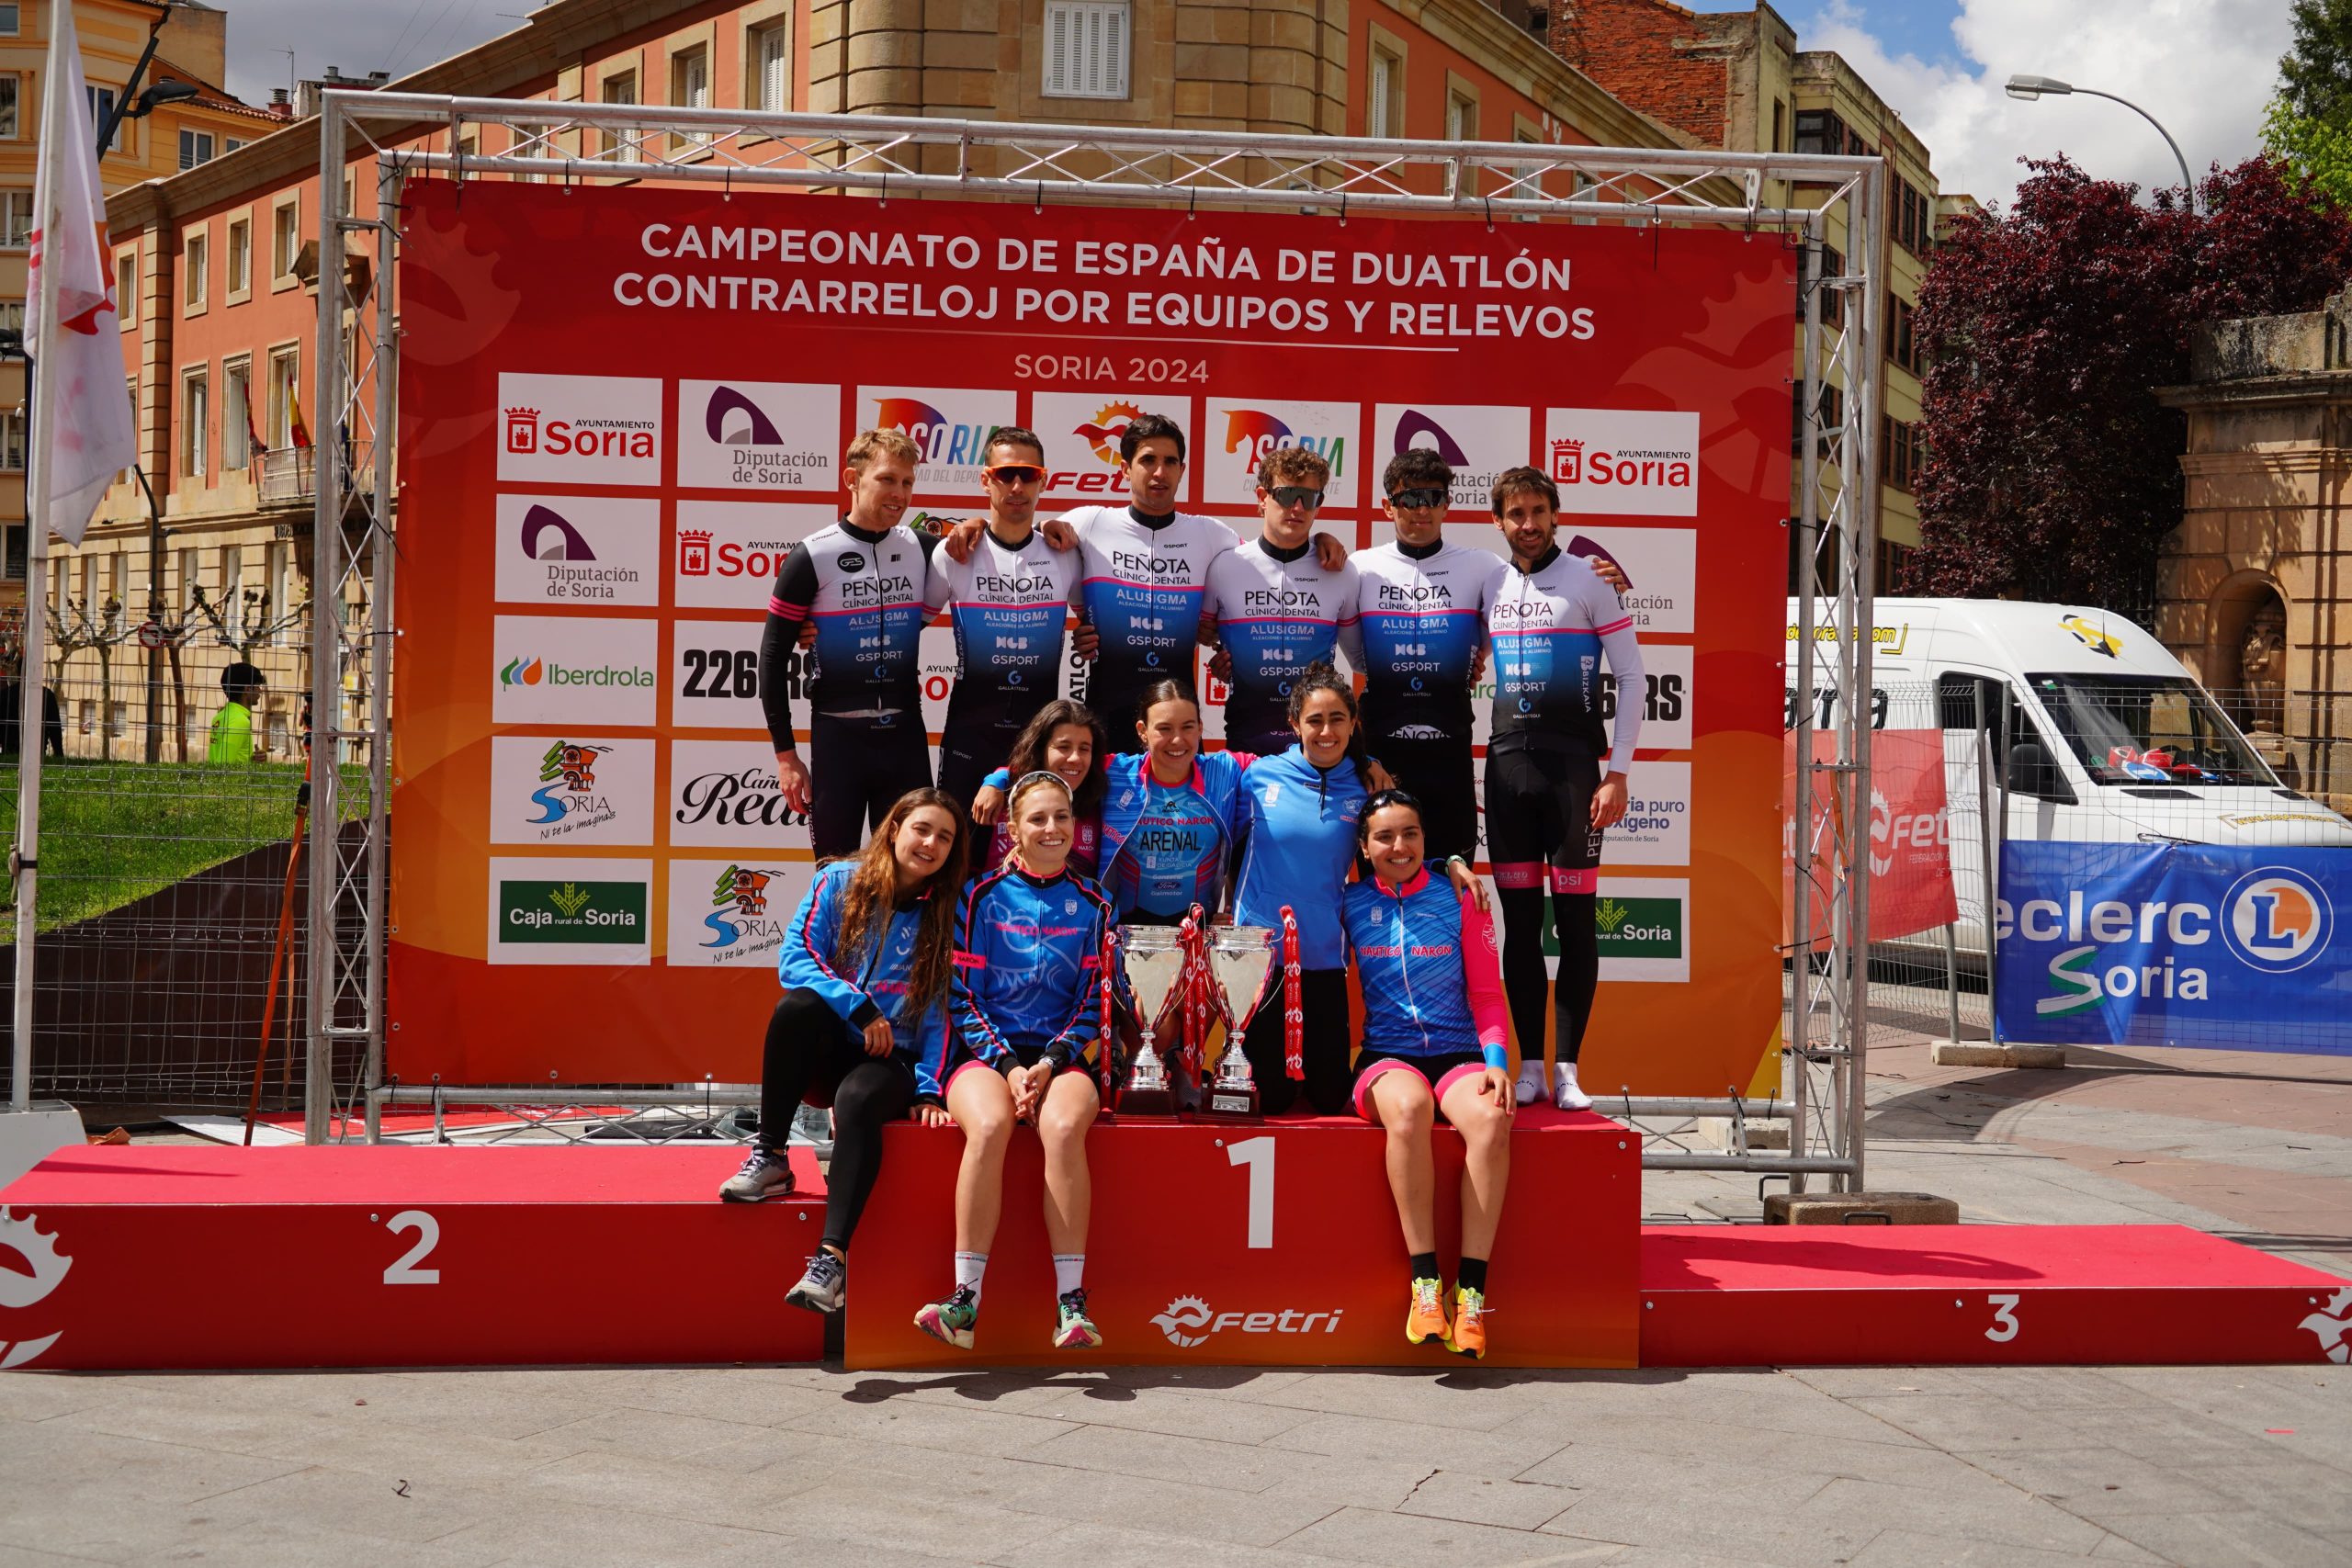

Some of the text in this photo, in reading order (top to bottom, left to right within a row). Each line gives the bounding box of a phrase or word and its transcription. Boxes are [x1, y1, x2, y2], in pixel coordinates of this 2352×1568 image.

[640, 223, 1572, 291] CAMPEONATO DE ESPAÑA DE DUATLÓN
[613, 272, 1596, 340] CONTRARRELOJ POR EQUIPOS Y RELEVOS
[1013, 354, 1209, 384] SORIA 2024
[574, 419, 655, 430] AYUNTAMIENTO
[543, 421, 654, 458] Soria
[732, 449, 829, 469] Diputación
[1616, 449, 1691, 459] AYUNTAMIENTO
[732, 468, 803, 485] de Soria
[1587, 451, 1690, 487] Soria
[1113, 550, 1191, 574] PEÑOTA
[547, 565, 639, 583] Diputación
[977, 573, 1054, 593] PEÑOTA
[1113, 568, 1192, 586] CLÍNICA DENTAL
[547, 582, 615, 598] de Soria
[842, 576, 912, 597] PEÑOTA
[1379, 583, 1452, 602] PEÑOTA
[842, 593, 914, 609] CLÍNICA DENTAL
[978, 592, 1054, 604] CLÍNICA DENTAL
[1116, 588, 1187, 604] ALUSIGMA
[1244, 586, 1320, 607] PEÑOTA
[1245, 607, 1320, 618] CLÍNICA DENTAL
[1378, 600, 1453, 612] CLÍNICA DENTAL
[1493, 599, 1554, 619] PEÑOTA
[984, 610, 1049, 622] ALUSIGMA
[1493, 619, 1555, 630] CLÍNICA DENTAL
[1250, 625, 1315, 636] ALUSIGMA
[1126, 635, 1177, 648] GSPORT
[855, 650, 903, 662] GSPORT
[991, 655, 1040, 665] GSPORT
[548, 664, 654, 687] Iberdrola
[1260, 666, 1307, 677] GSPORT
[1391, 661, 1441, 673] GSPORT
[1505, 682, 1546, 693] GSPORT
[1581, 671, 1592, 714] BIZKAIA
[526, 782, 612, 824] SORIA
[1649, 800, 1685, 817] puro
[1137, 817, 1174, 826] AUTICO
[1605, 813, 1670, 833] xígeno
[1140, 830, 1202, 852] ARENAL
[1558, 873, 1582, 887] psi
[509, 908, 553, 929] Caja
[584, 908, 636, 926] Soria
[1623, 924, 1672, 941] Soria
[1360, 944, 1452, 957] NAUTICO NARON
[2036, 944, 2209, 1015] Soria
[1226, 1136, 1274, 1249] 1
[382, 1210, 441, 1285] 2
[1984, 1293, 2020, 1343] 3
